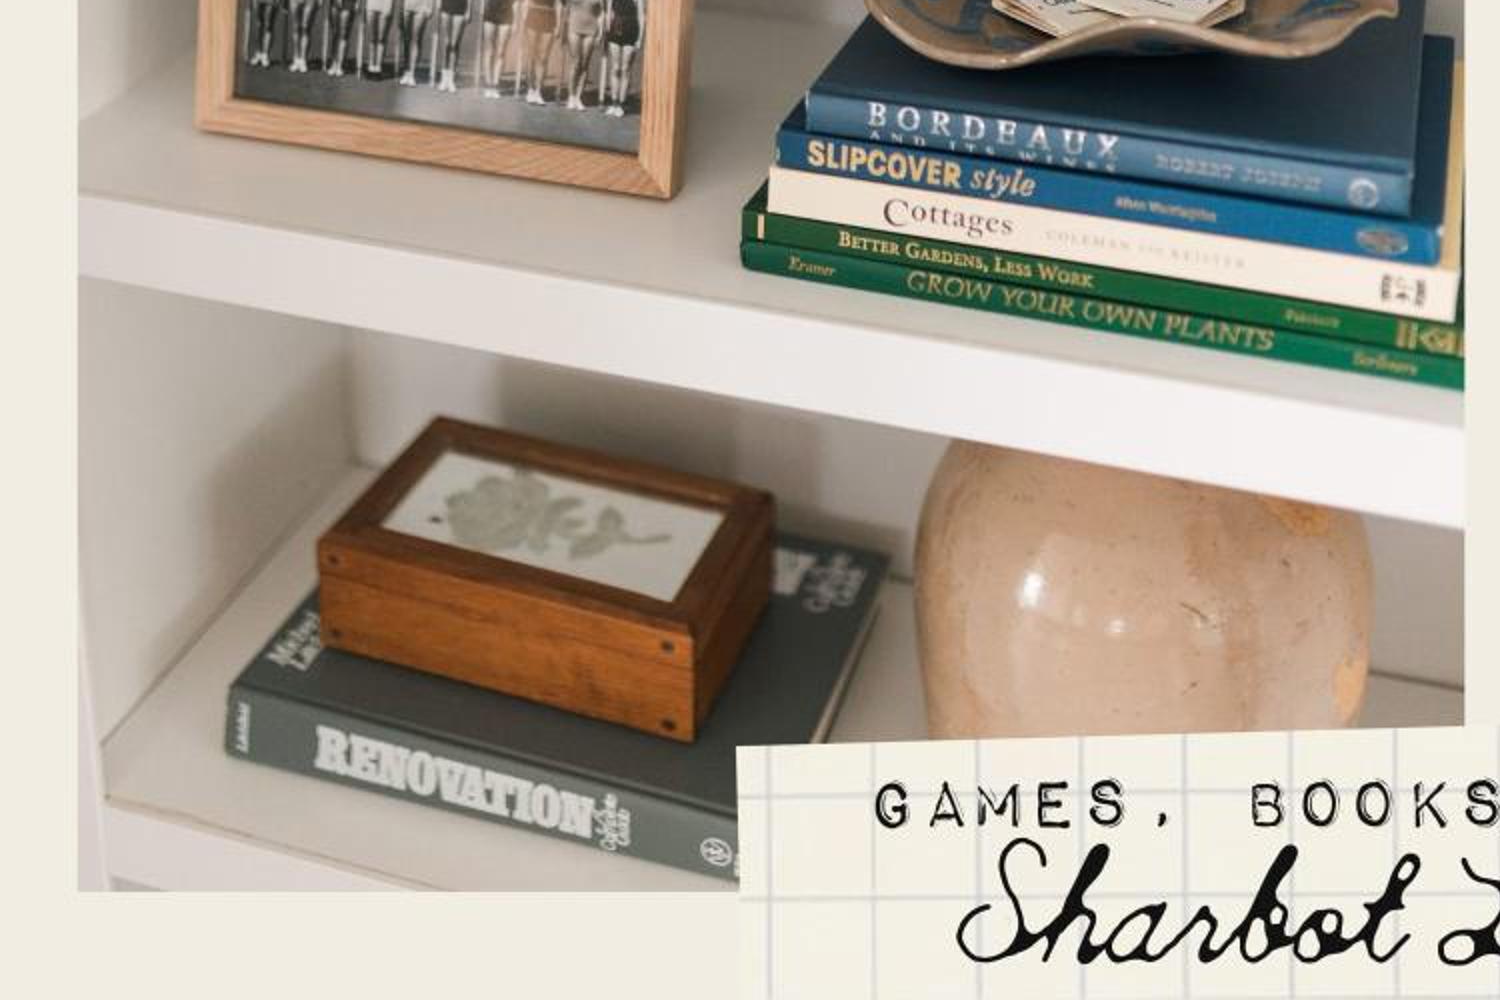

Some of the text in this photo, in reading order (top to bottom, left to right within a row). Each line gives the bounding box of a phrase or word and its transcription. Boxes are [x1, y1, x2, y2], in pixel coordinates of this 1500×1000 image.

[867, 101, 1120, 158] BORDEAUX
[869, 130, 1118, 173] AND ITS WINES
[807, 139, 1037, 199] SLIPCOVER style
[1155, 154, 1235, 181] ROBERT
[883, 199, 1015, 238] Cottages
[906, 270, 994, 302] GROW
[1002, 283, 1078, 319] YOUR
[1083, 299, 1158, 330] OWN
[1163, 311, 1275, 351] PLANTS
[314, 724, 597, 840] RENOVATION
